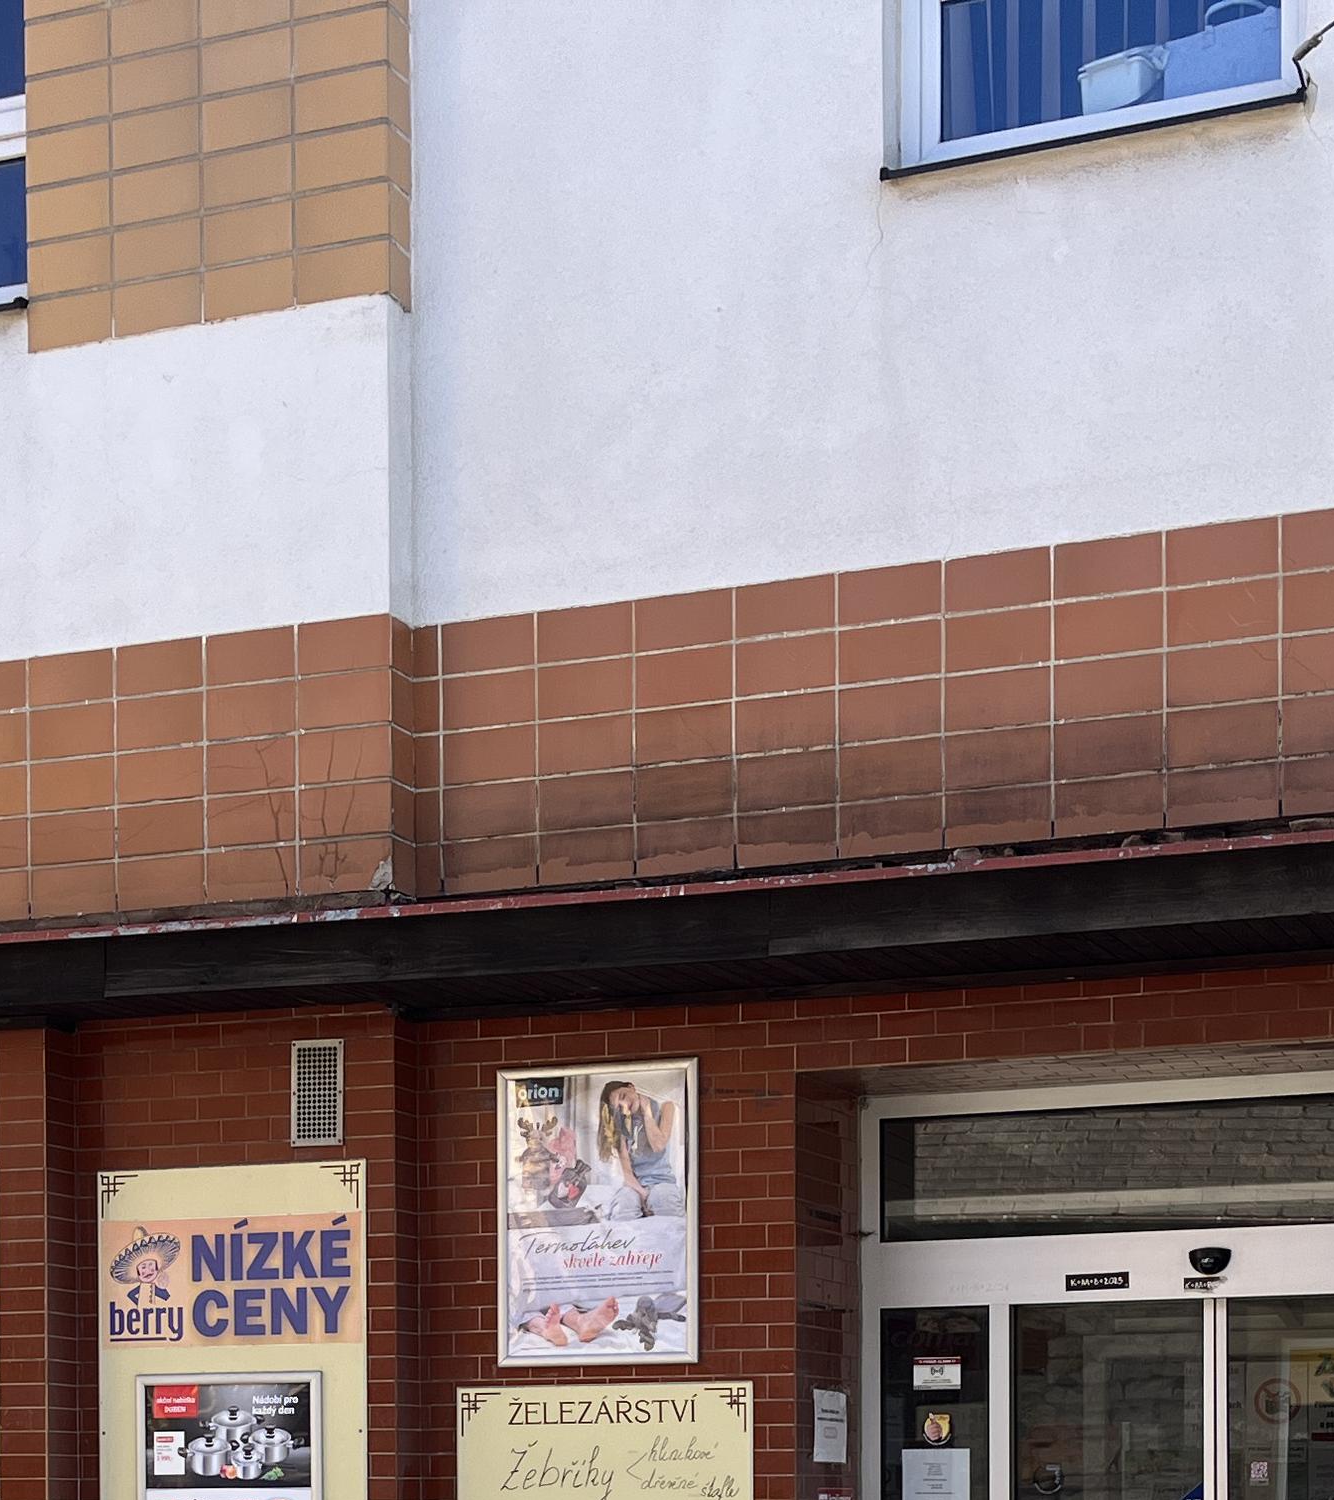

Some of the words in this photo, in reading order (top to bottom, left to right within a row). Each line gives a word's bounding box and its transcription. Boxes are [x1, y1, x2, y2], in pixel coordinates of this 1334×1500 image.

[517, 1085, 560, 1101] orion
[191, 1214, 351, 1282] NÍZKÉ
[519, 1229, 636, 1260] Termoláhev
[563, 1252, 606, 1270] skvěle
[610, 1250, 663, 1270] zahřeje
[109, 1301, 183, 1341] berry
[192, 1286, 351, 1337] CENY
[252, 1395, 283, 1405] Nádobí
[283, 1396, 299, 1406] pro
[278, 1406, 295, 1415] den
[508, 1394, 698, 1426] ŽELEZÁŘSTVÍ
